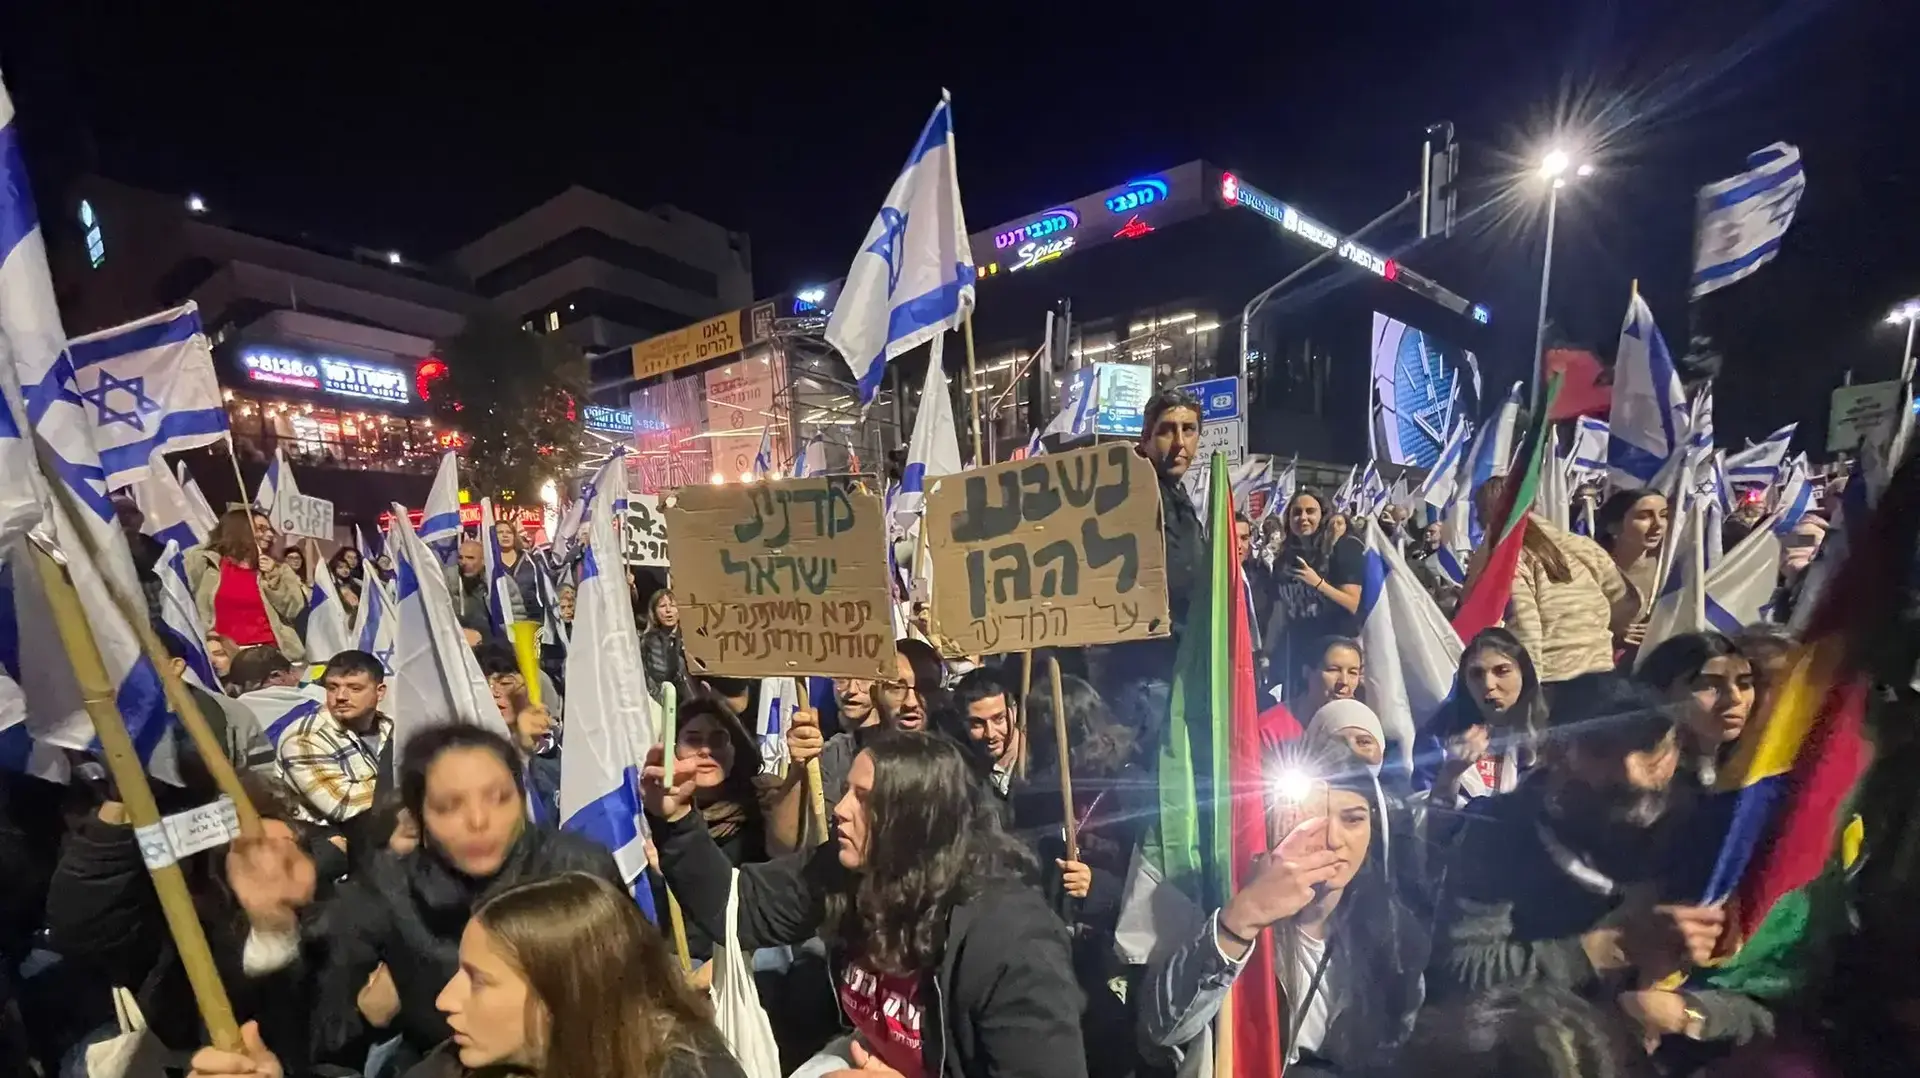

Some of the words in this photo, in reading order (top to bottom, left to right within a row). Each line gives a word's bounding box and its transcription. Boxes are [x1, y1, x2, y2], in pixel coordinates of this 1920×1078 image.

[1106, 188, 1155, 213] מכבי
[995, 215, 1067, 249] מכבידנט
[1011, 236, 1076, 272] Spices
[702, 320, 728, 339] באנו
[1215, 396, 1228, 406] 22
[289, 495, 332, 521] RISE
[734, 486, 855, 548] מדינת
[719, 549, 838, 595] ישראל
[966, 517, 1139, 619] להגן
[690, 593, 726, 630] על
[970, 606, 1068, 650] המדינה
[1093, 596, 1139, 634] על
